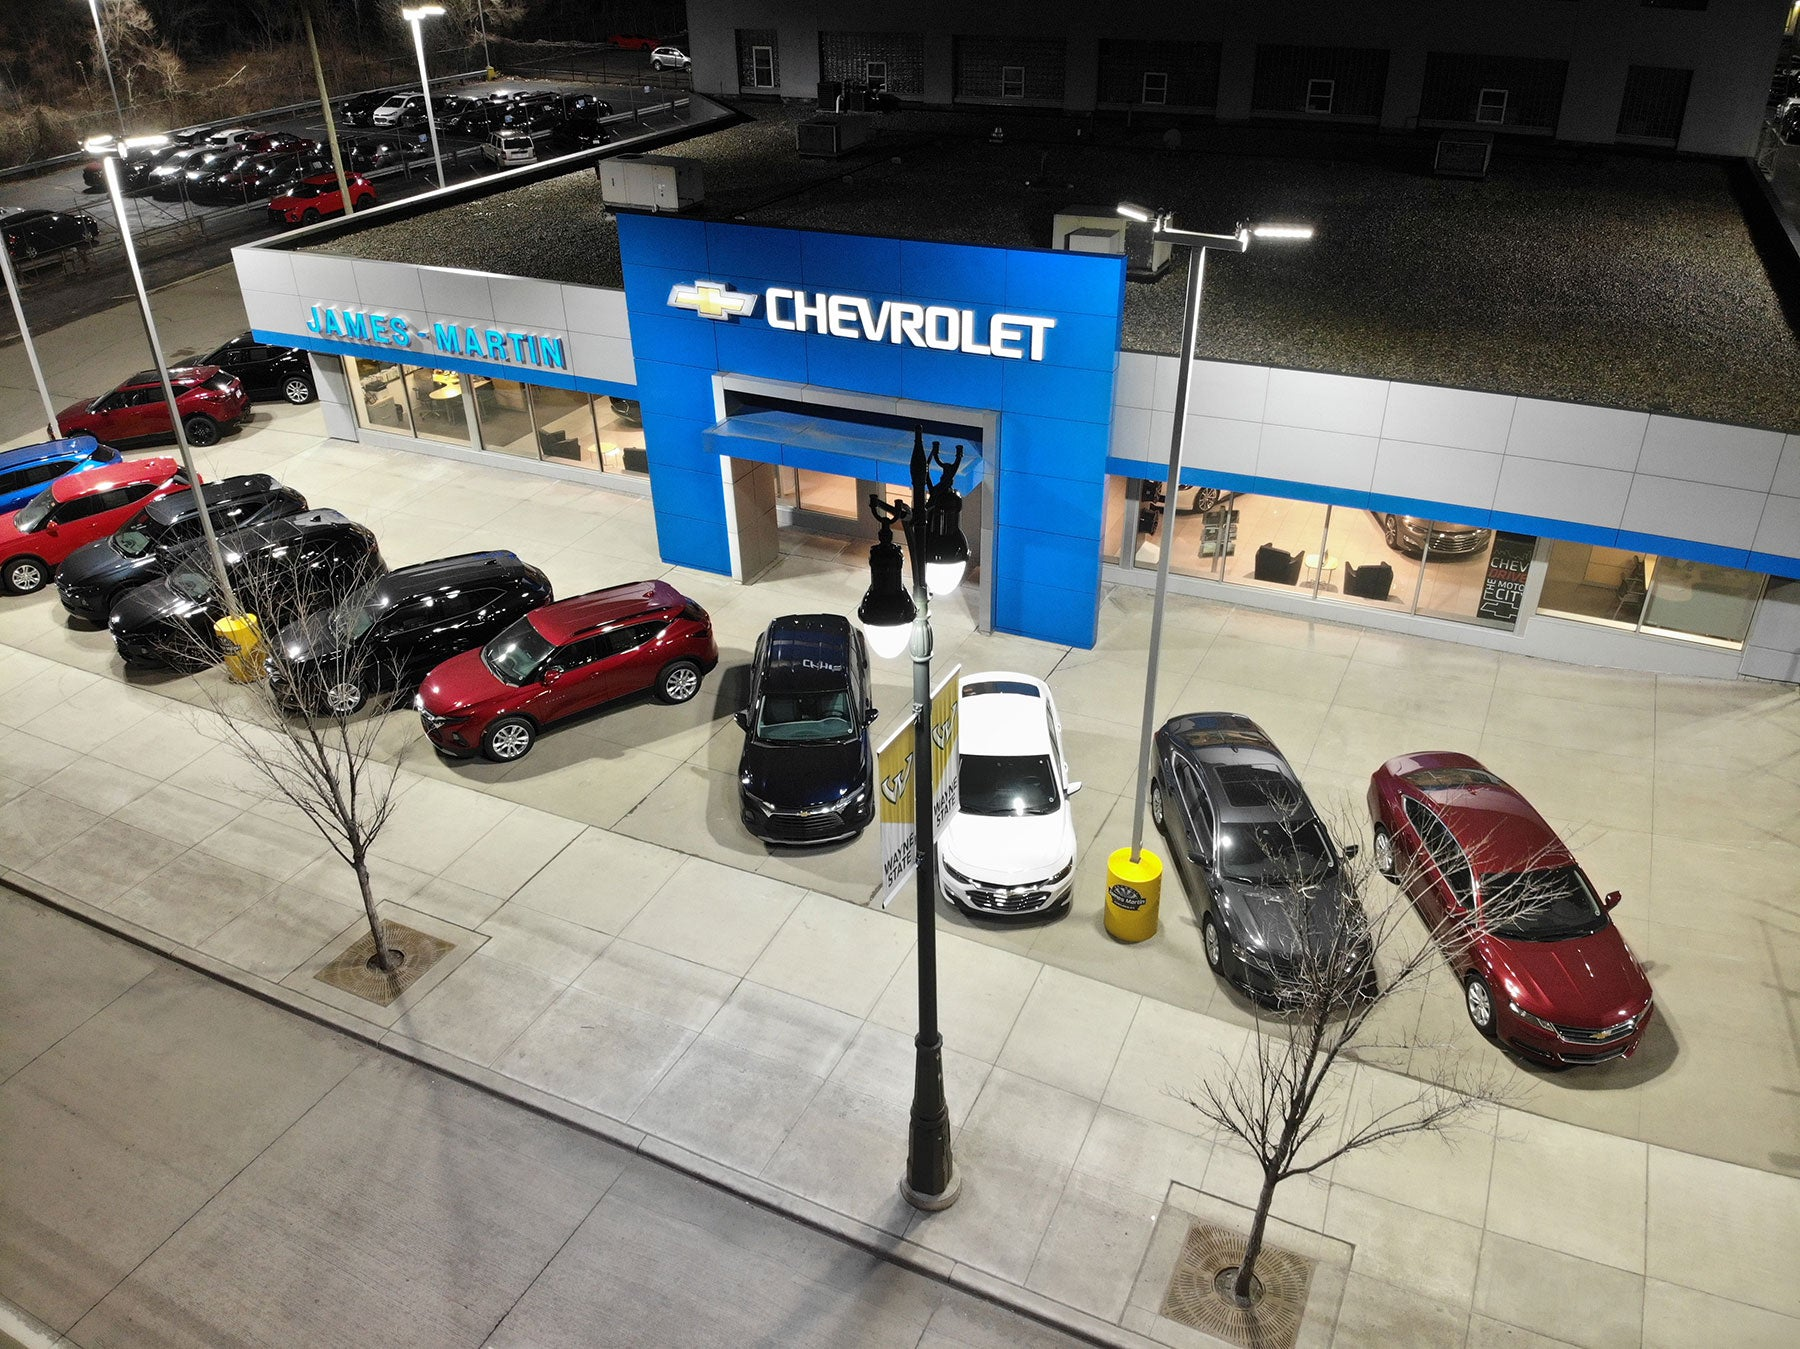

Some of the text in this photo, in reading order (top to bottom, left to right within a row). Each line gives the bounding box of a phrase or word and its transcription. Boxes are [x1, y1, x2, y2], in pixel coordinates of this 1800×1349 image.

[306, 304, 411, 348] JAMES
[433, 321, 567, 368] MARTIN
[765, 286, 1056, 362] CHEVROLET
[1495, 588, 1524, 602] CIT
[933, 776, 957, 816] WAYNE
[936, 792, 956, 828] STATE
[884, 832, 914, 875] WAYNE
[888, 849, 912, 888] STATE
